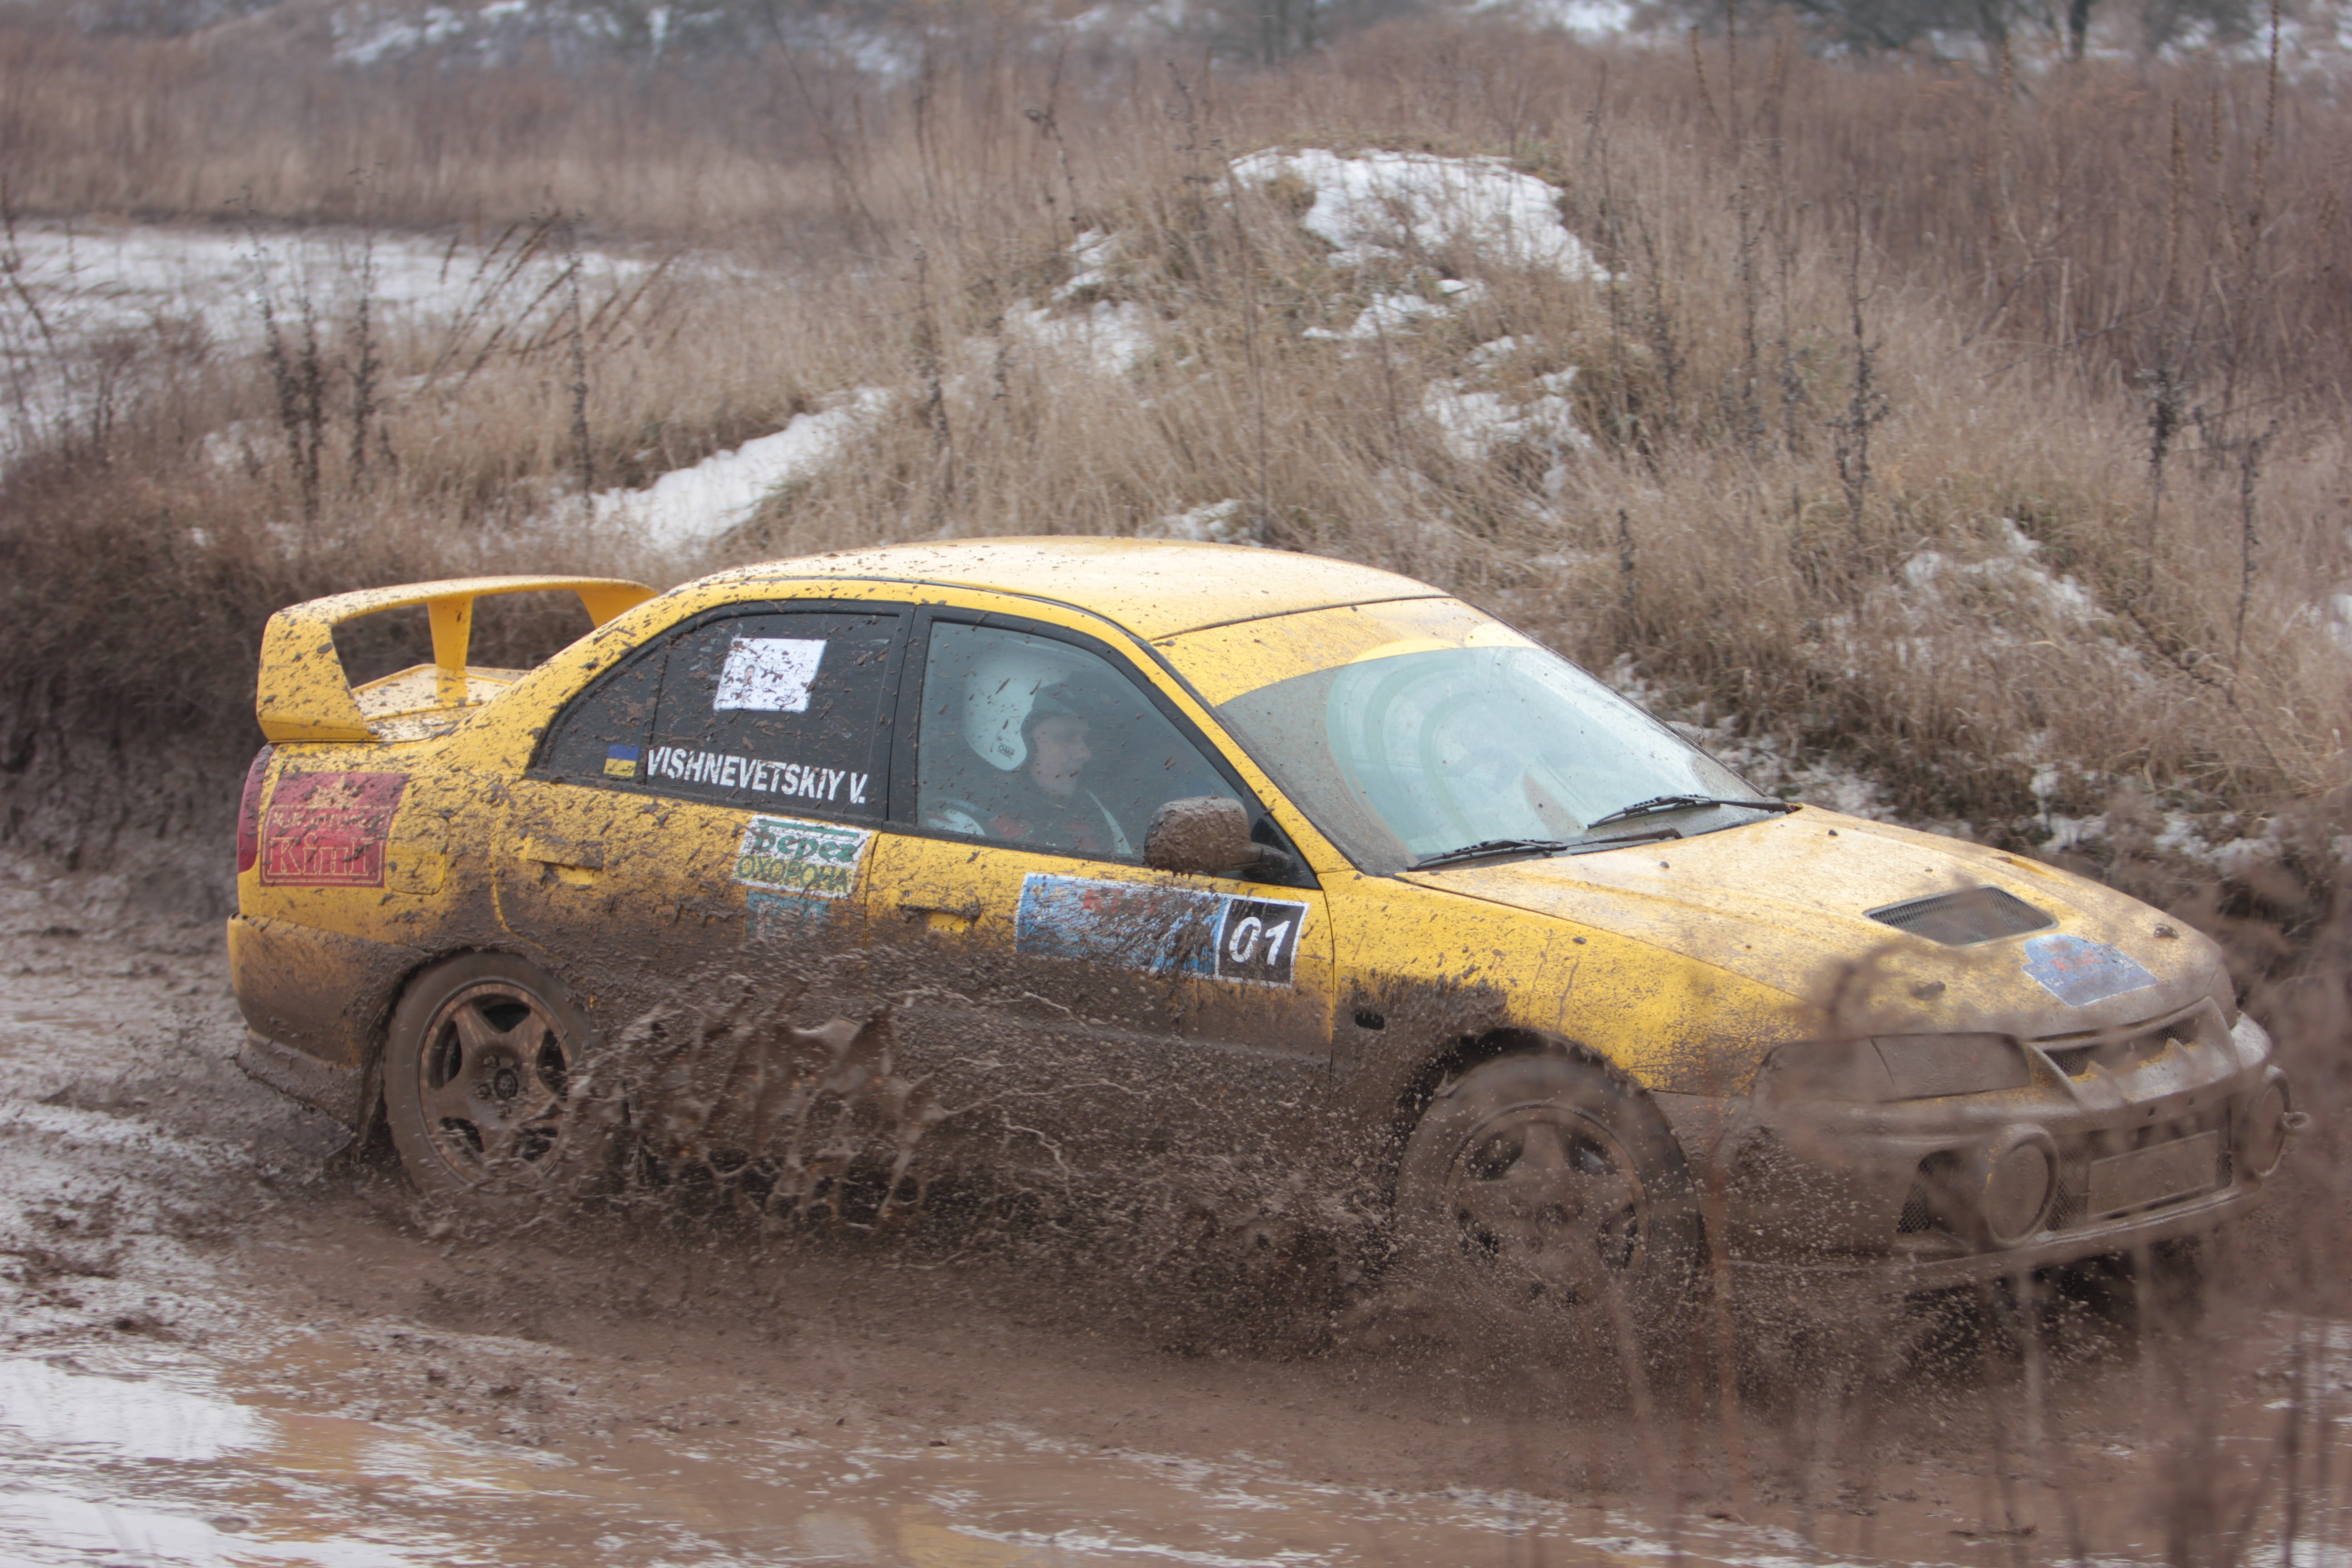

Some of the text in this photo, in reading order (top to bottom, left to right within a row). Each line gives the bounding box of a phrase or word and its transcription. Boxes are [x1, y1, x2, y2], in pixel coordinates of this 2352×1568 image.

[998, 745, 1014, 756] OMP
[647, 746, 868, 804] VISHNEVETSKIY V.
[737, 855, 848, 893] ОХОРОНА
[1229, 916, 1291, 966] 01
